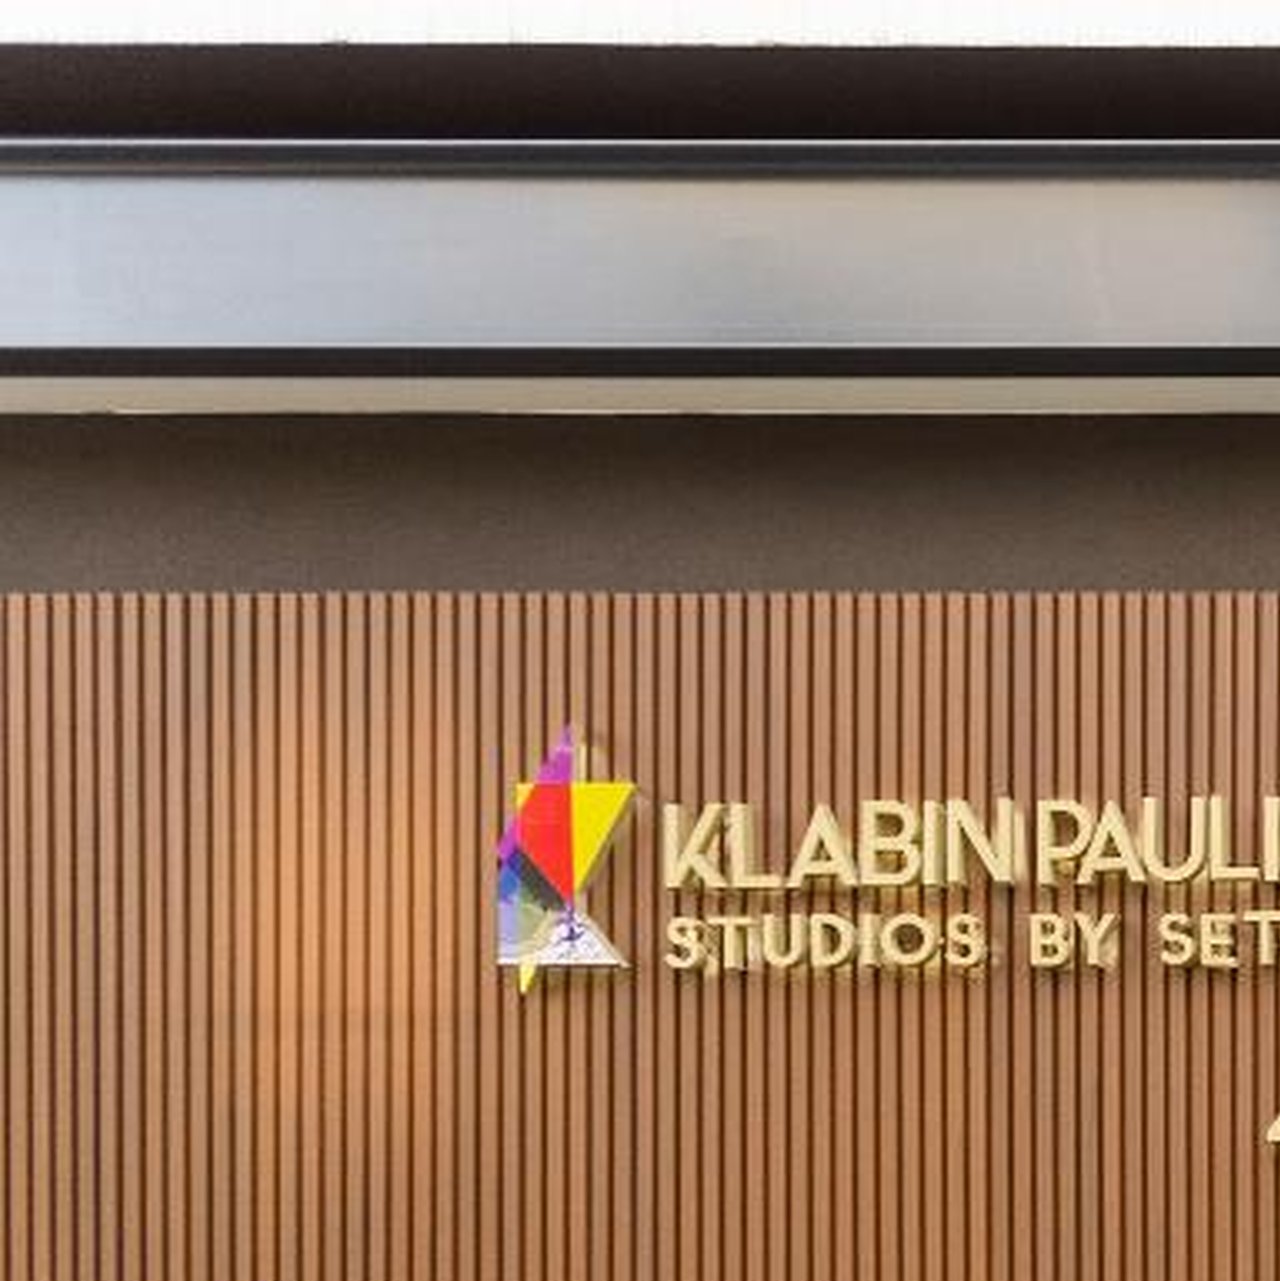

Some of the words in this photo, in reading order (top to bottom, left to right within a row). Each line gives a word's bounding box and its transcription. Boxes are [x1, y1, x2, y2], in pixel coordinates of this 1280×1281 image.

[663, 796, 1018, 890] KLABIN
[664, 911, 990, 970] STUDIOS
[1029, 910, 1119, 968] BY
